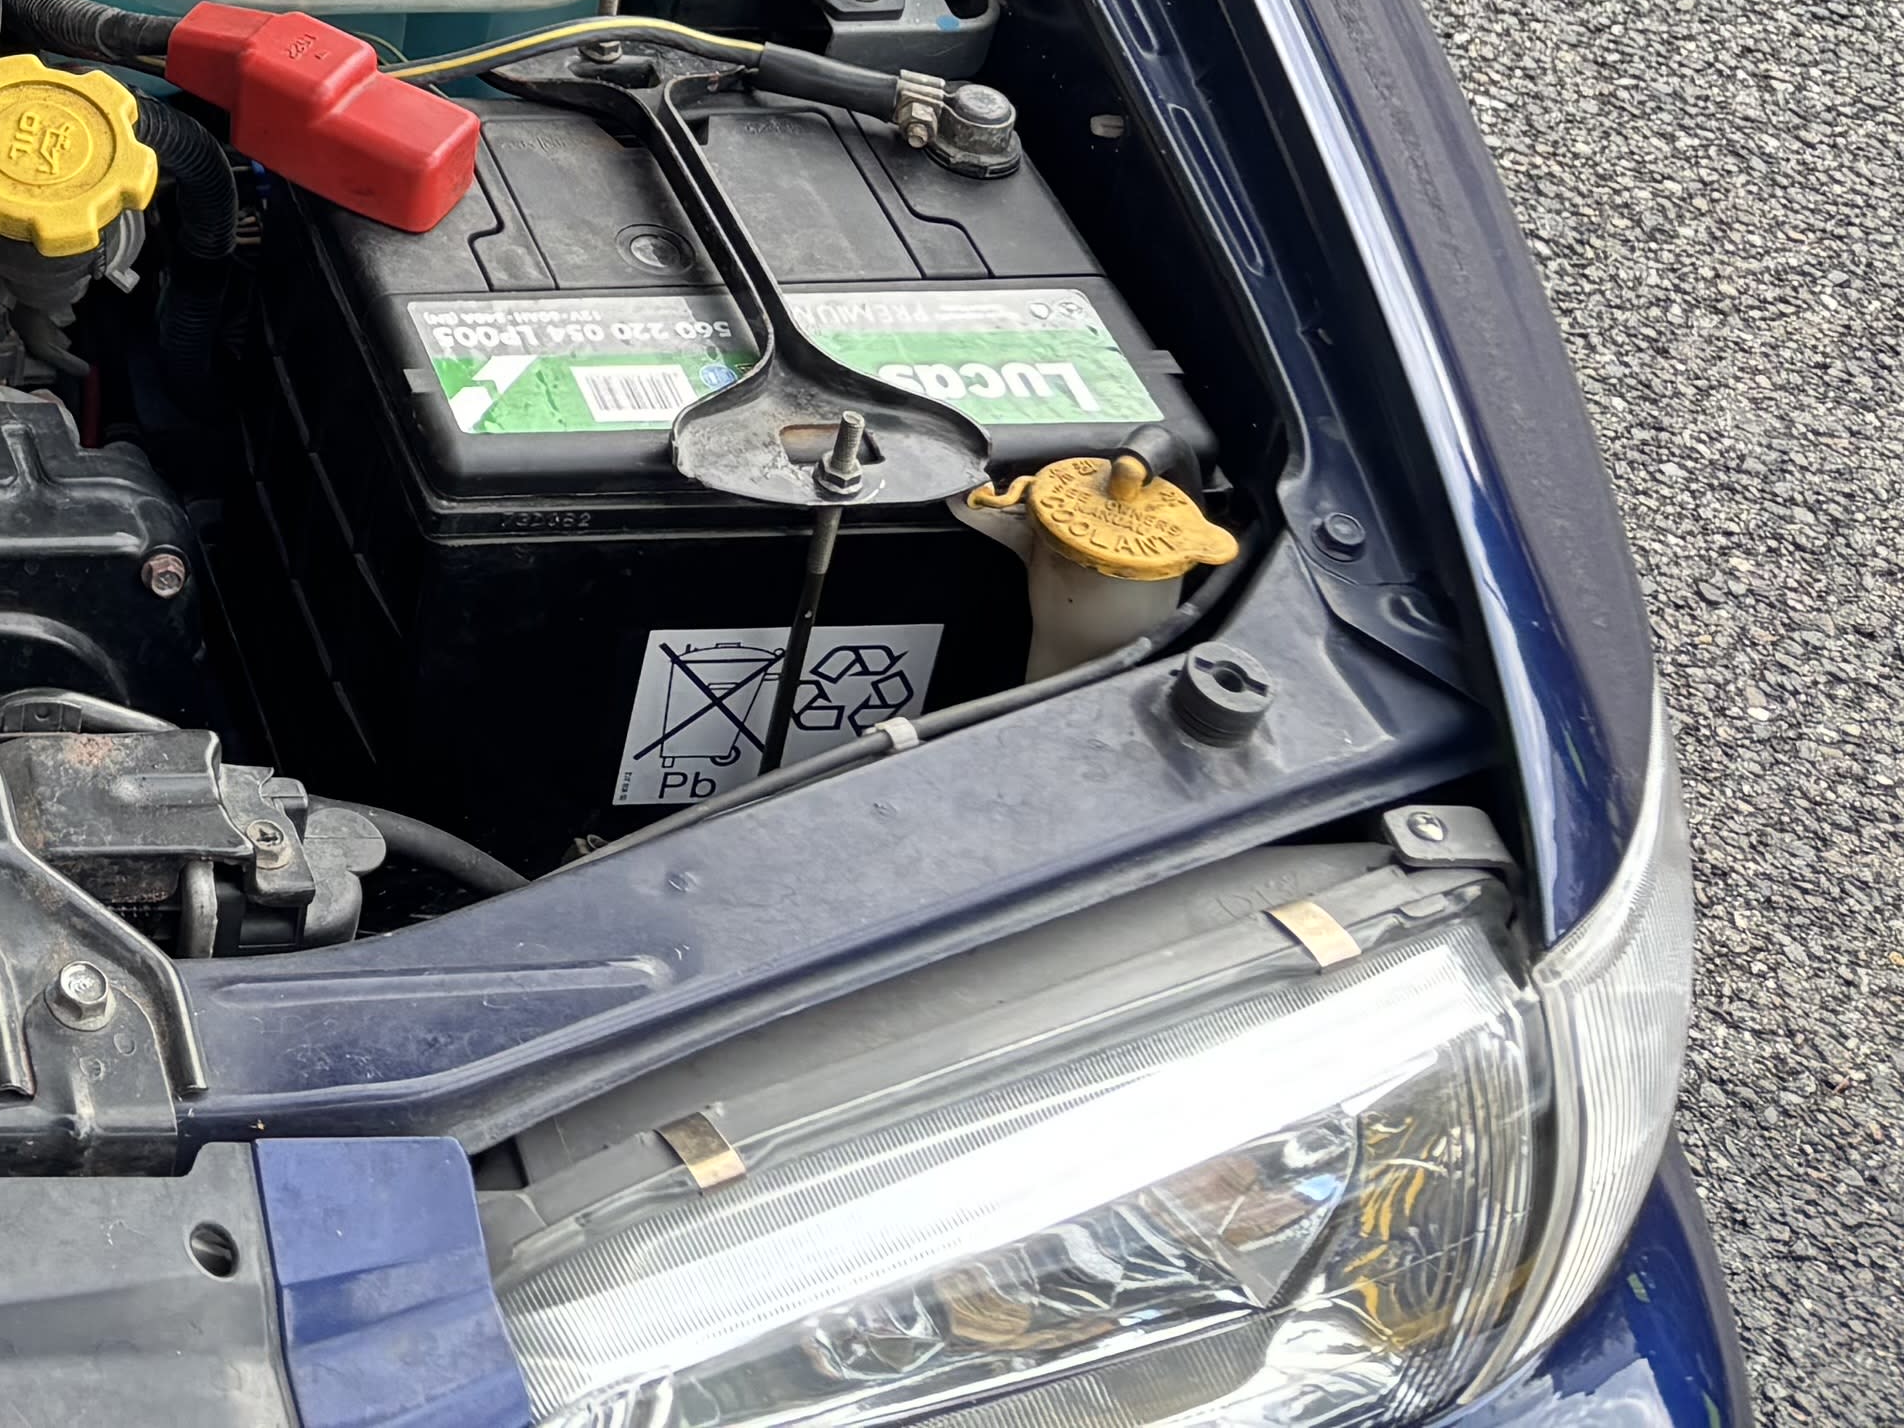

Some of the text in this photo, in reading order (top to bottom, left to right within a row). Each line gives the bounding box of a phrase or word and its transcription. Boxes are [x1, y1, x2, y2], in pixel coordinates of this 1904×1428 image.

[9, 110, 40, 160] OIL
[611, 322, 670, 341] 220
[676, 320, 732, 339] 560
[1040, 496, 1176, 556] COOLANT
[658, 771, 717, 800] Pb
